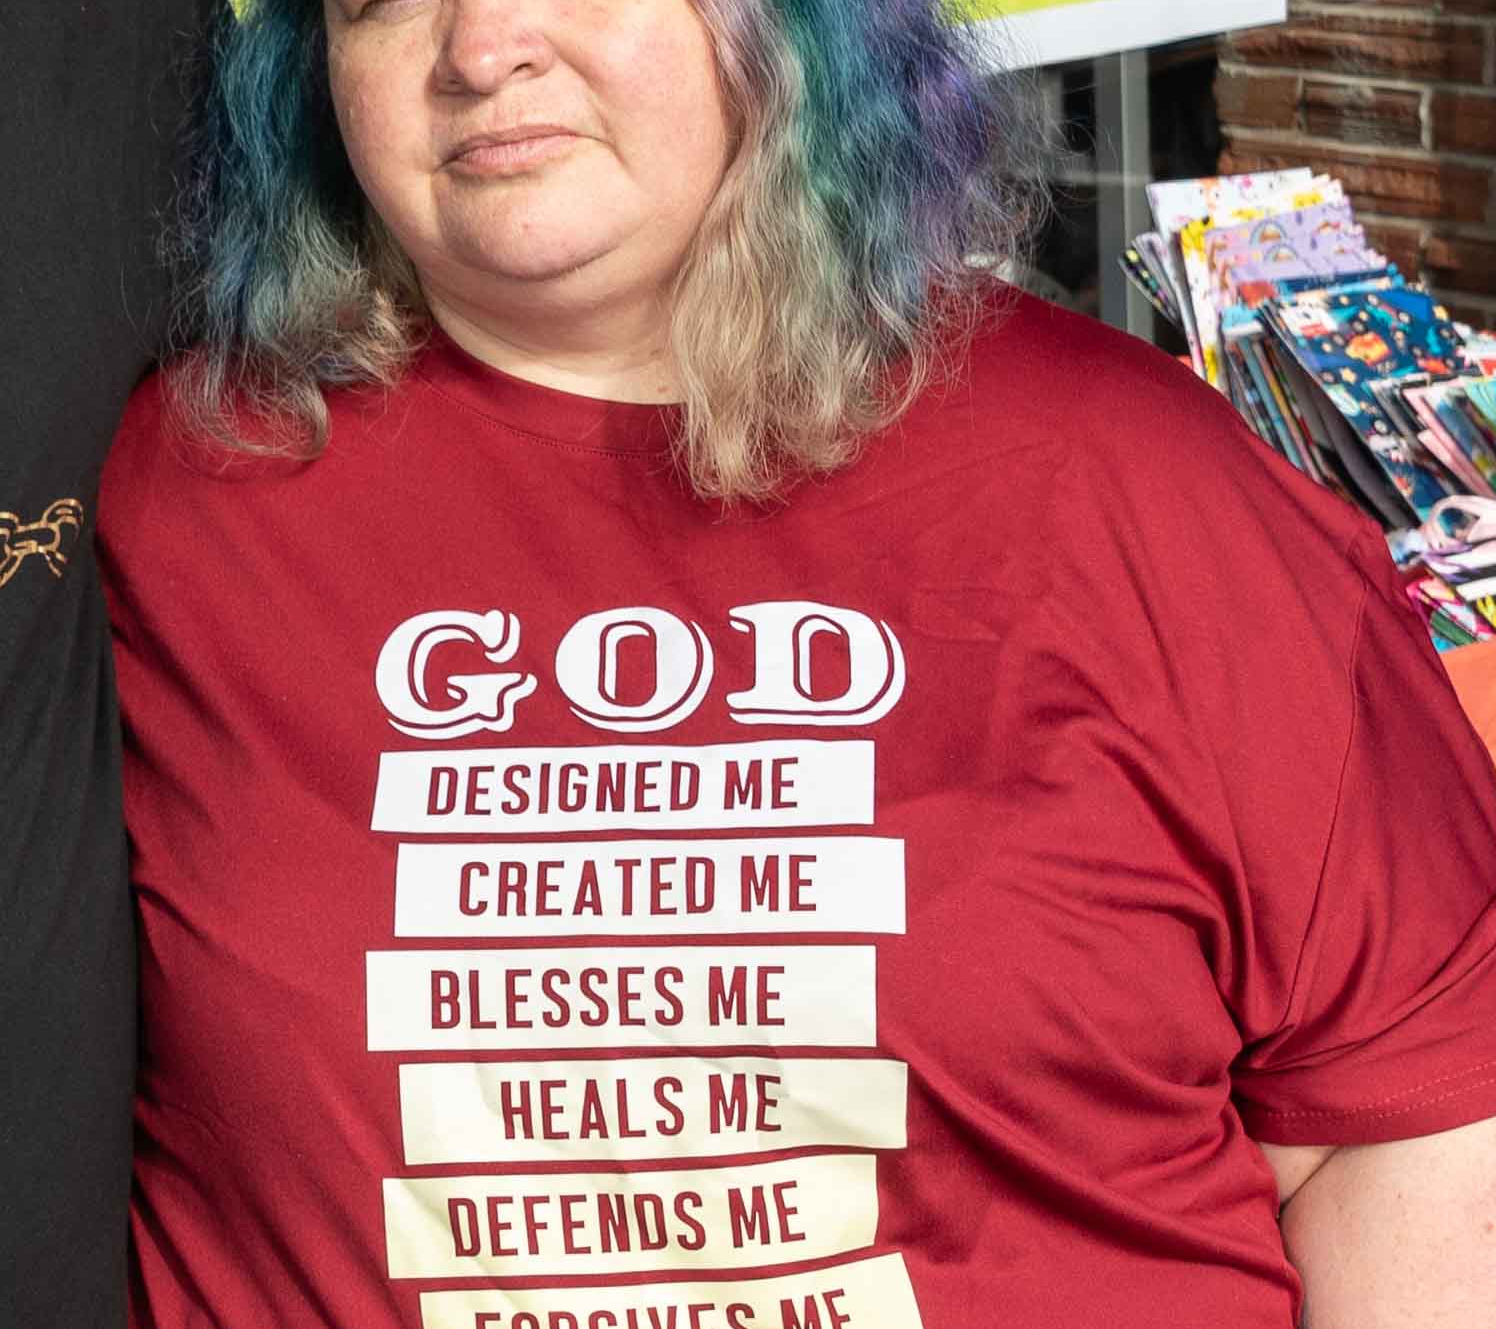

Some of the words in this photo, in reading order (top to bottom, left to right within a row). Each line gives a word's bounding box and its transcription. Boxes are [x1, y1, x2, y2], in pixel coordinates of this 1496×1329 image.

[375, 600, 906, 740] GOD
[426, 761, 701, 816] DESIGNED
[724, 757, 798, 810] ME
[459, 856, 715, 917] CREATED
[740, 855, 817, 913] ME
[430, 967, 684, 1030] BLESSES
[709, 965, 785, 1027] ME
[500, 1076, 684, 1140] HEALS
[708, 1074, 783, 1134] ME
[447, 1192, 706, 1258] DEFENDS
[728, 1180, 806, 1248] ME
